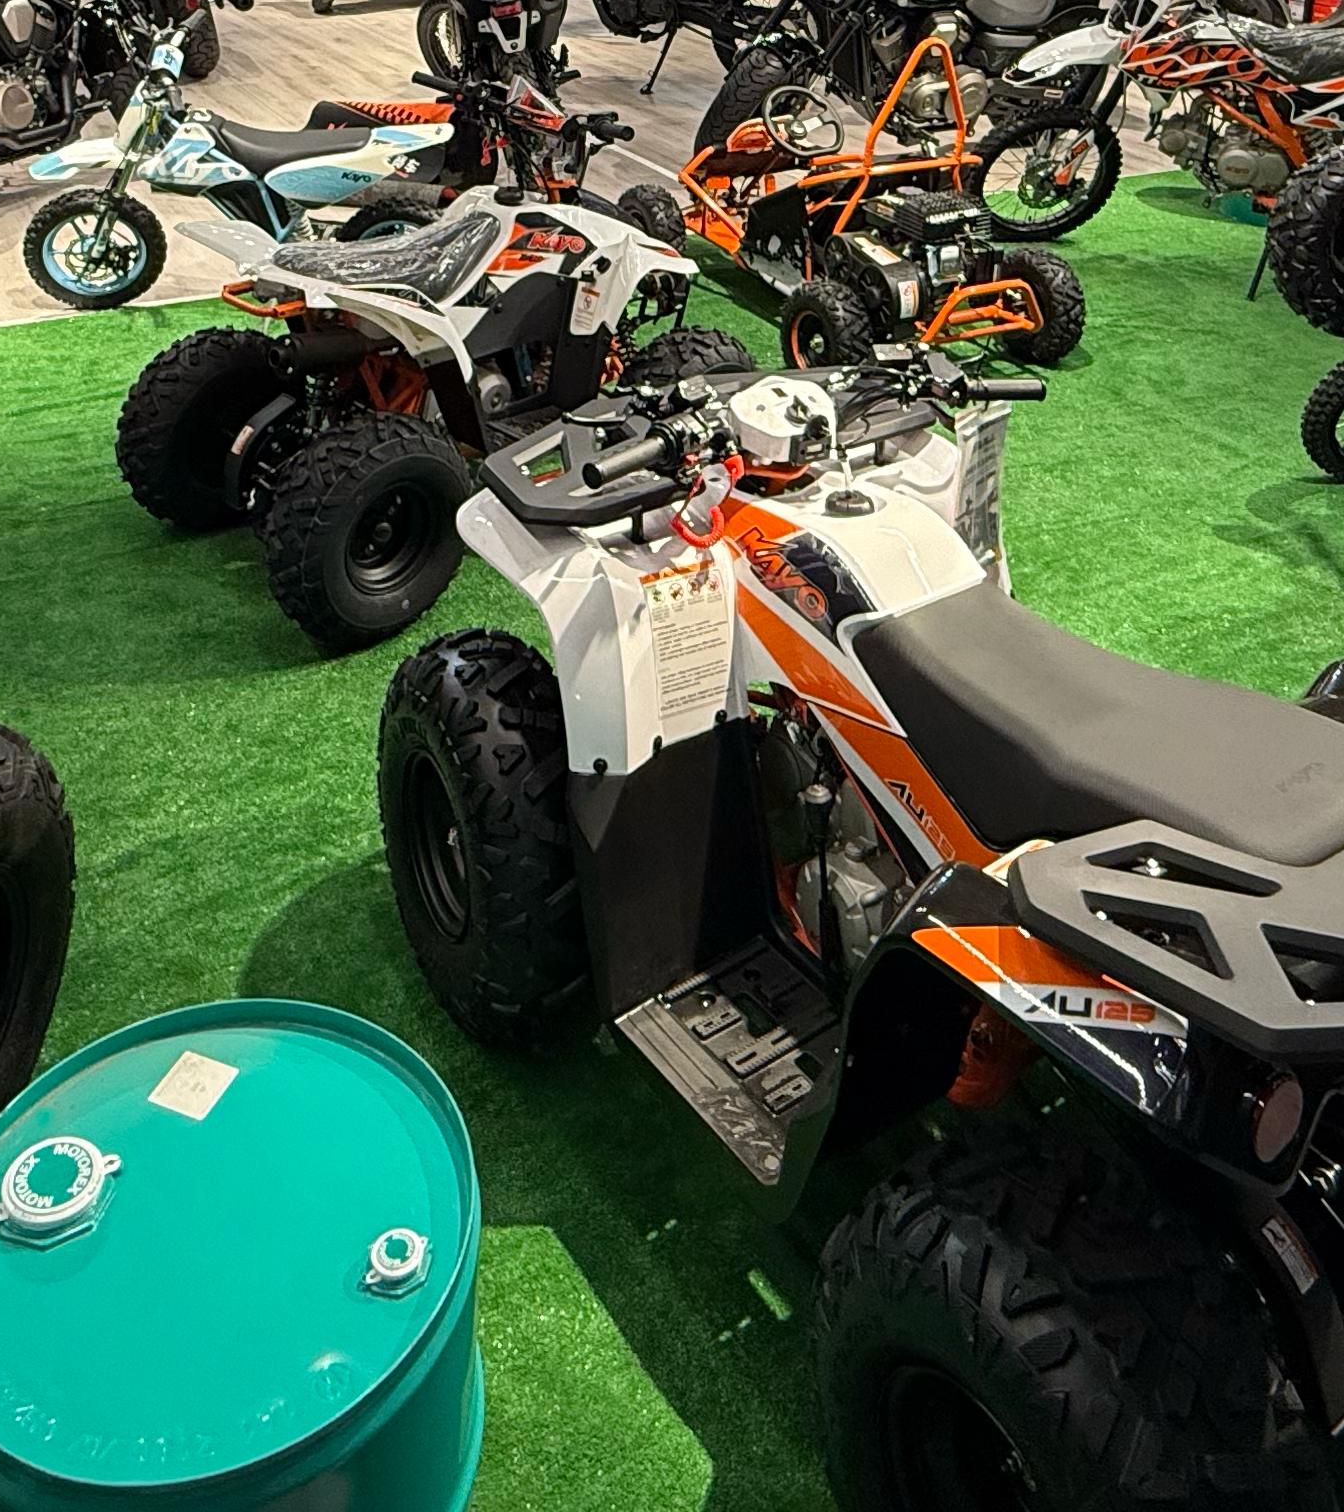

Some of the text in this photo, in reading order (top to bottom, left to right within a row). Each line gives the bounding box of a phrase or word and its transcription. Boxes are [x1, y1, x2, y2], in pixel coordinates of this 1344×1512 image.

[341, 171, 372, 183] KAYO
[734, 524, 829, 621] KAYO
[1024, 990, 1157, 1024] AU125
[53, 1143, 92, 1196] MOTOREX
